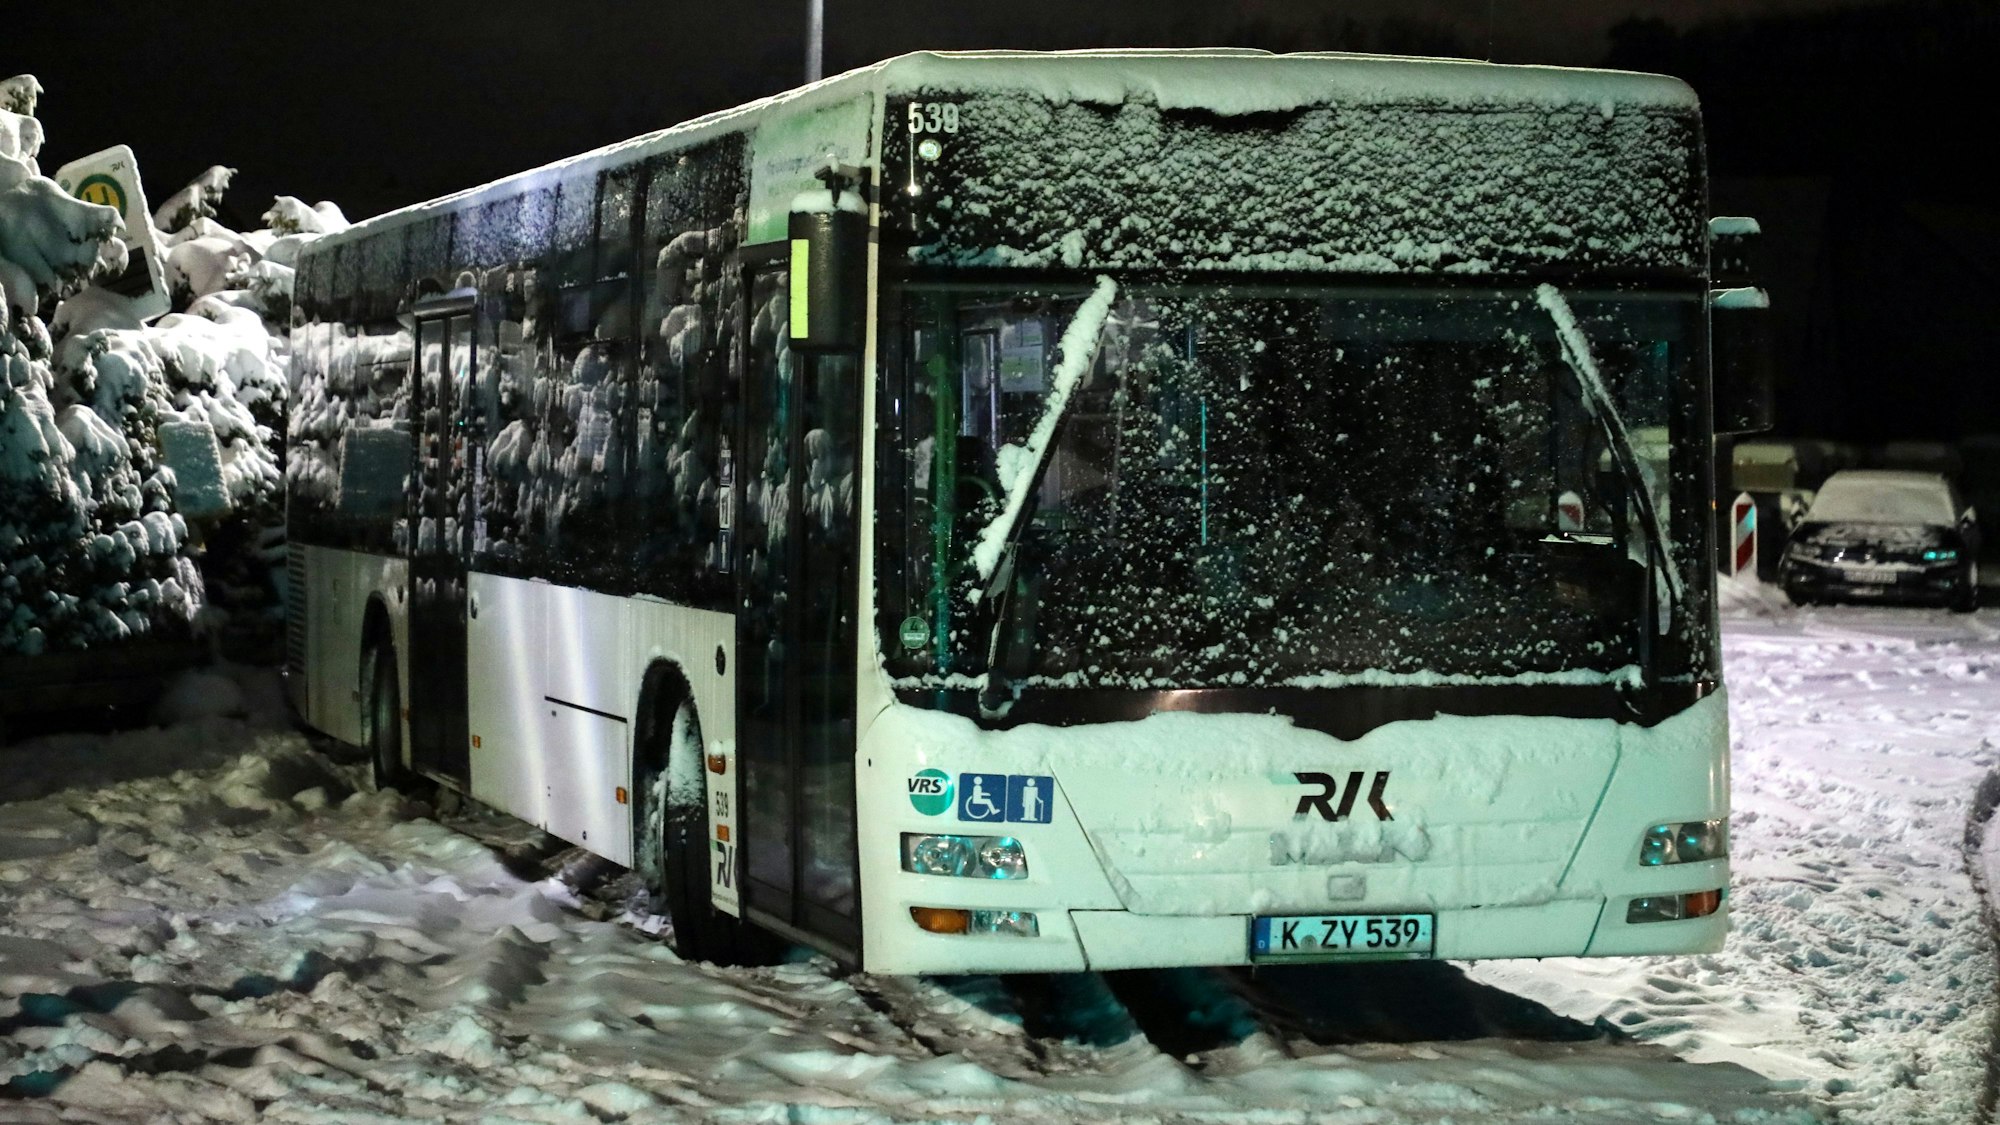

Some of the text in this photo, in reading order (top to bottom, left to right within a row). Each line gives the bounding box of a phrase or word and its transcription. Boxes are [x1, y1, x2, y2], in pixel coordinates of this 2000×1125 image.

[908, 102, 959, 134] 539
[908, 778, 943, 794] VRS
[716, 790, 729, 818] 539
[1269, 825, 1433, 866] MN
[1257, 919, 1420, 949] D K ZY 539
